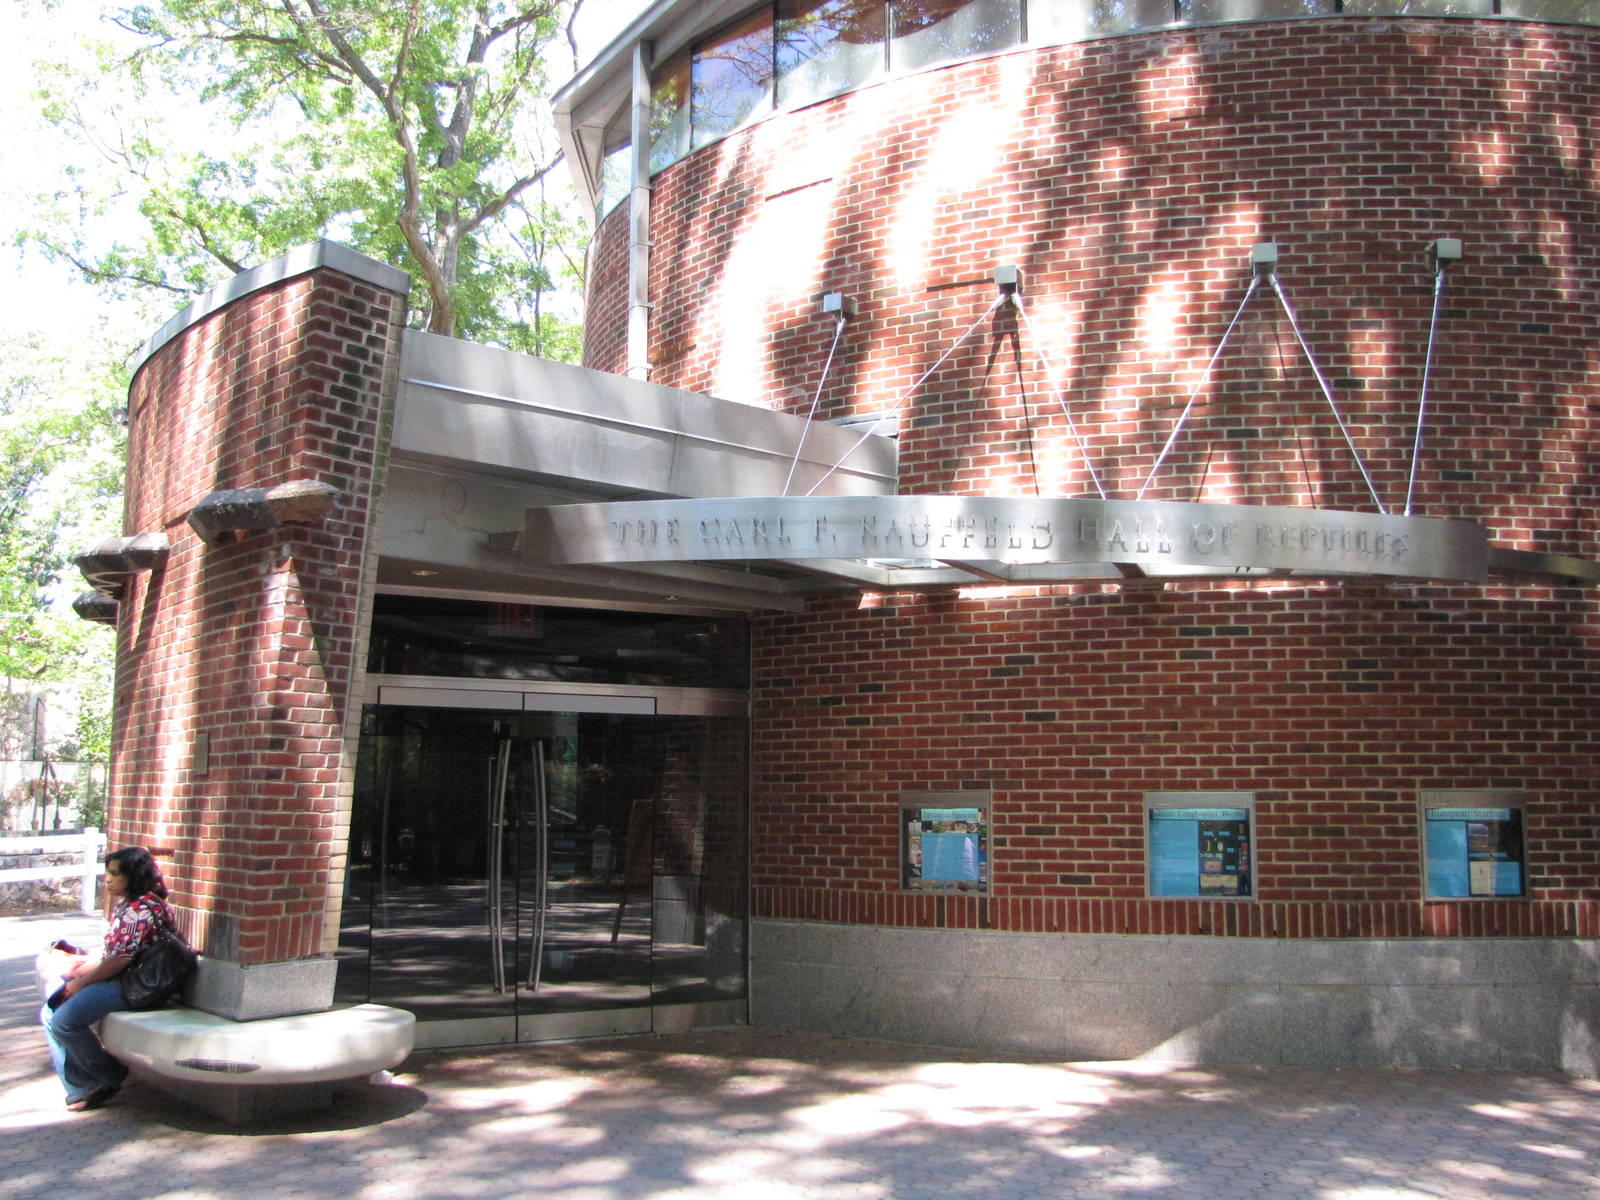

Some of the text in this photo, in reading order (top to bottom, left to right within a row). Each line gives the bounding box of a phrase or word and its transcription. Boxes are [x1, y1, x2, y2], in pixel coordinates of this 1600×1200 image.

[611, 517, 681, 544] THE
[697, 517, 792, 545] CARL
[861, 513, 1054, 550] KAUFFELD
[1077, 515, 1172, 554] HALL
[1192, 520, 1239, 556] OF
[1256, 521, 1409, 556] REPTILES
